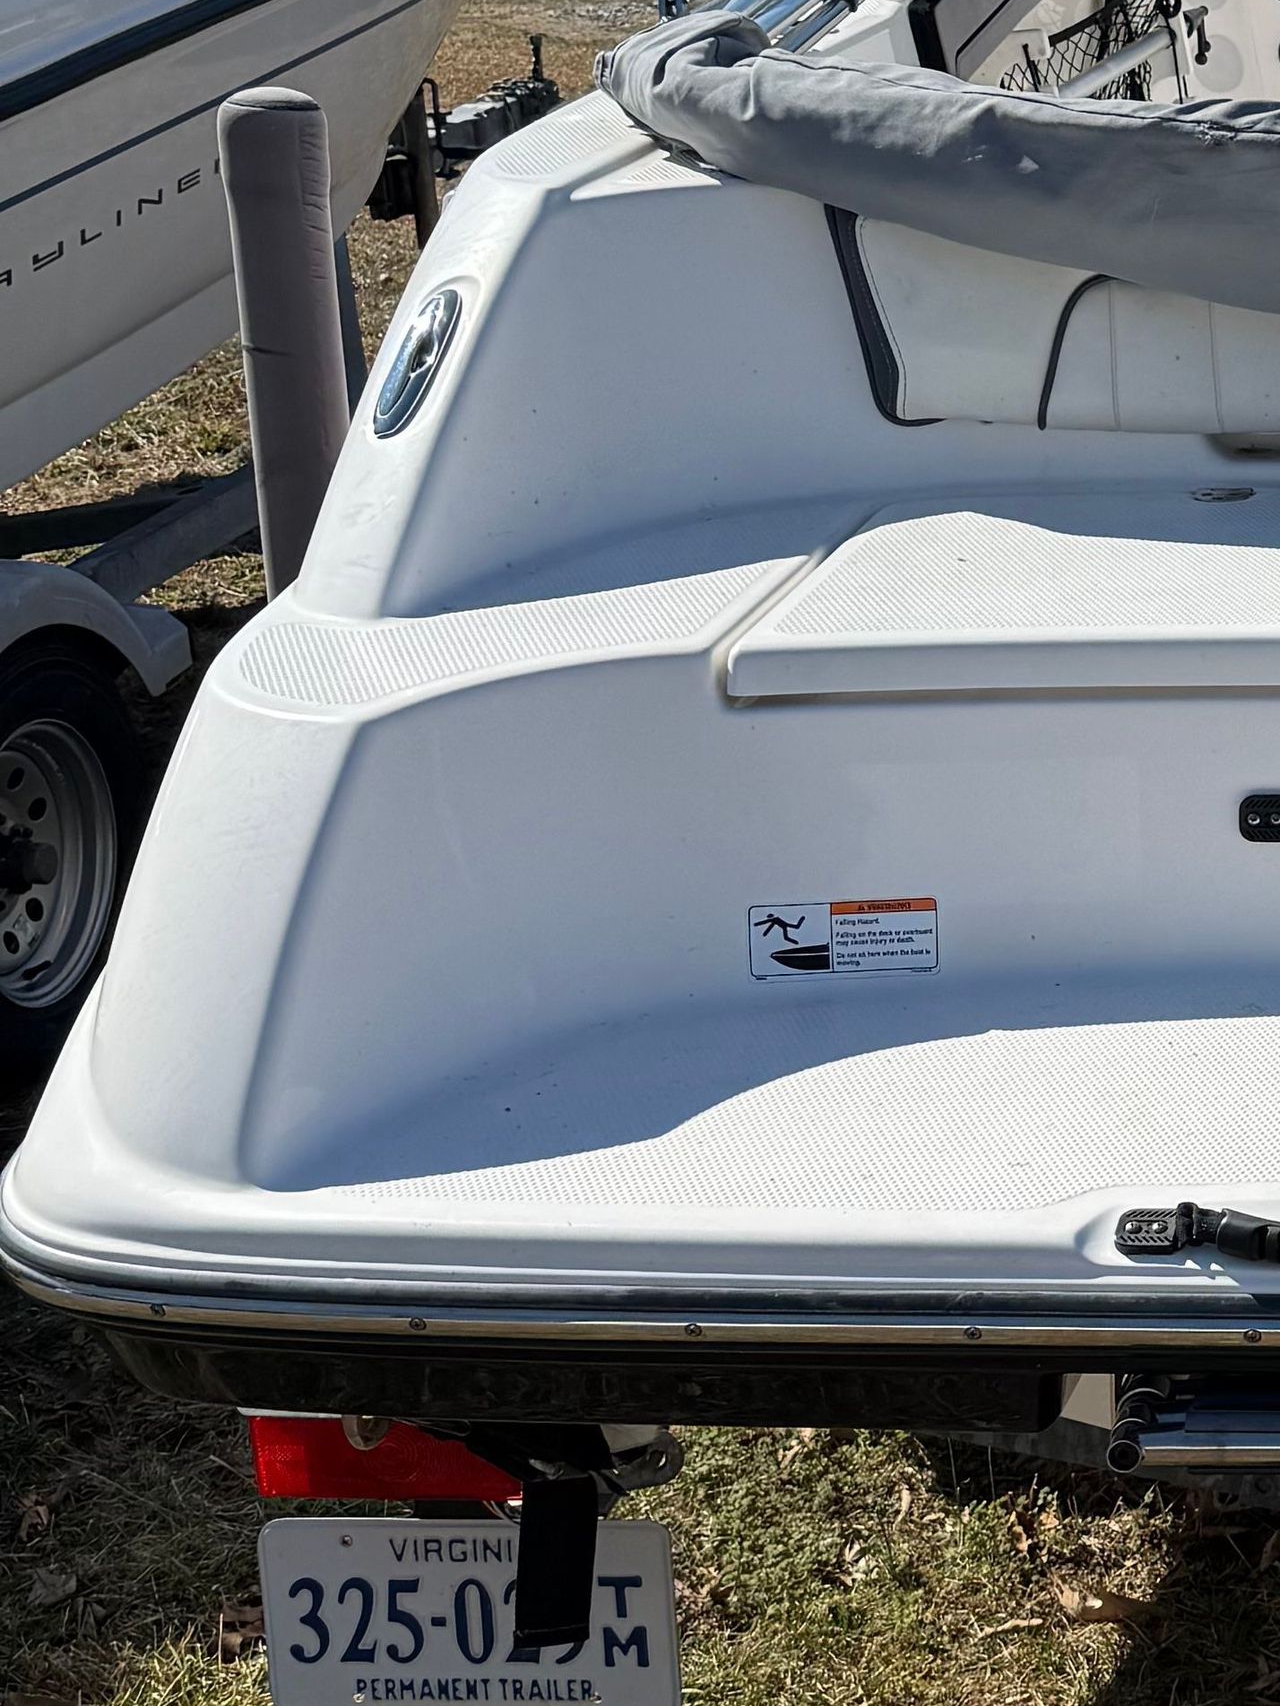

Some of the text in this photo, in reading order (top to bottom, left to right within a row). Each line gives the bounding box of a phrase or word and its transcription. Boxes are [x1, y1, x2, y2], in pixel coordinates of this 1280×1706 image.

[389, 1537, 514, 1563] VIRGINI
[356, 1677, 594, 1703] PERMANENT TRAILER
